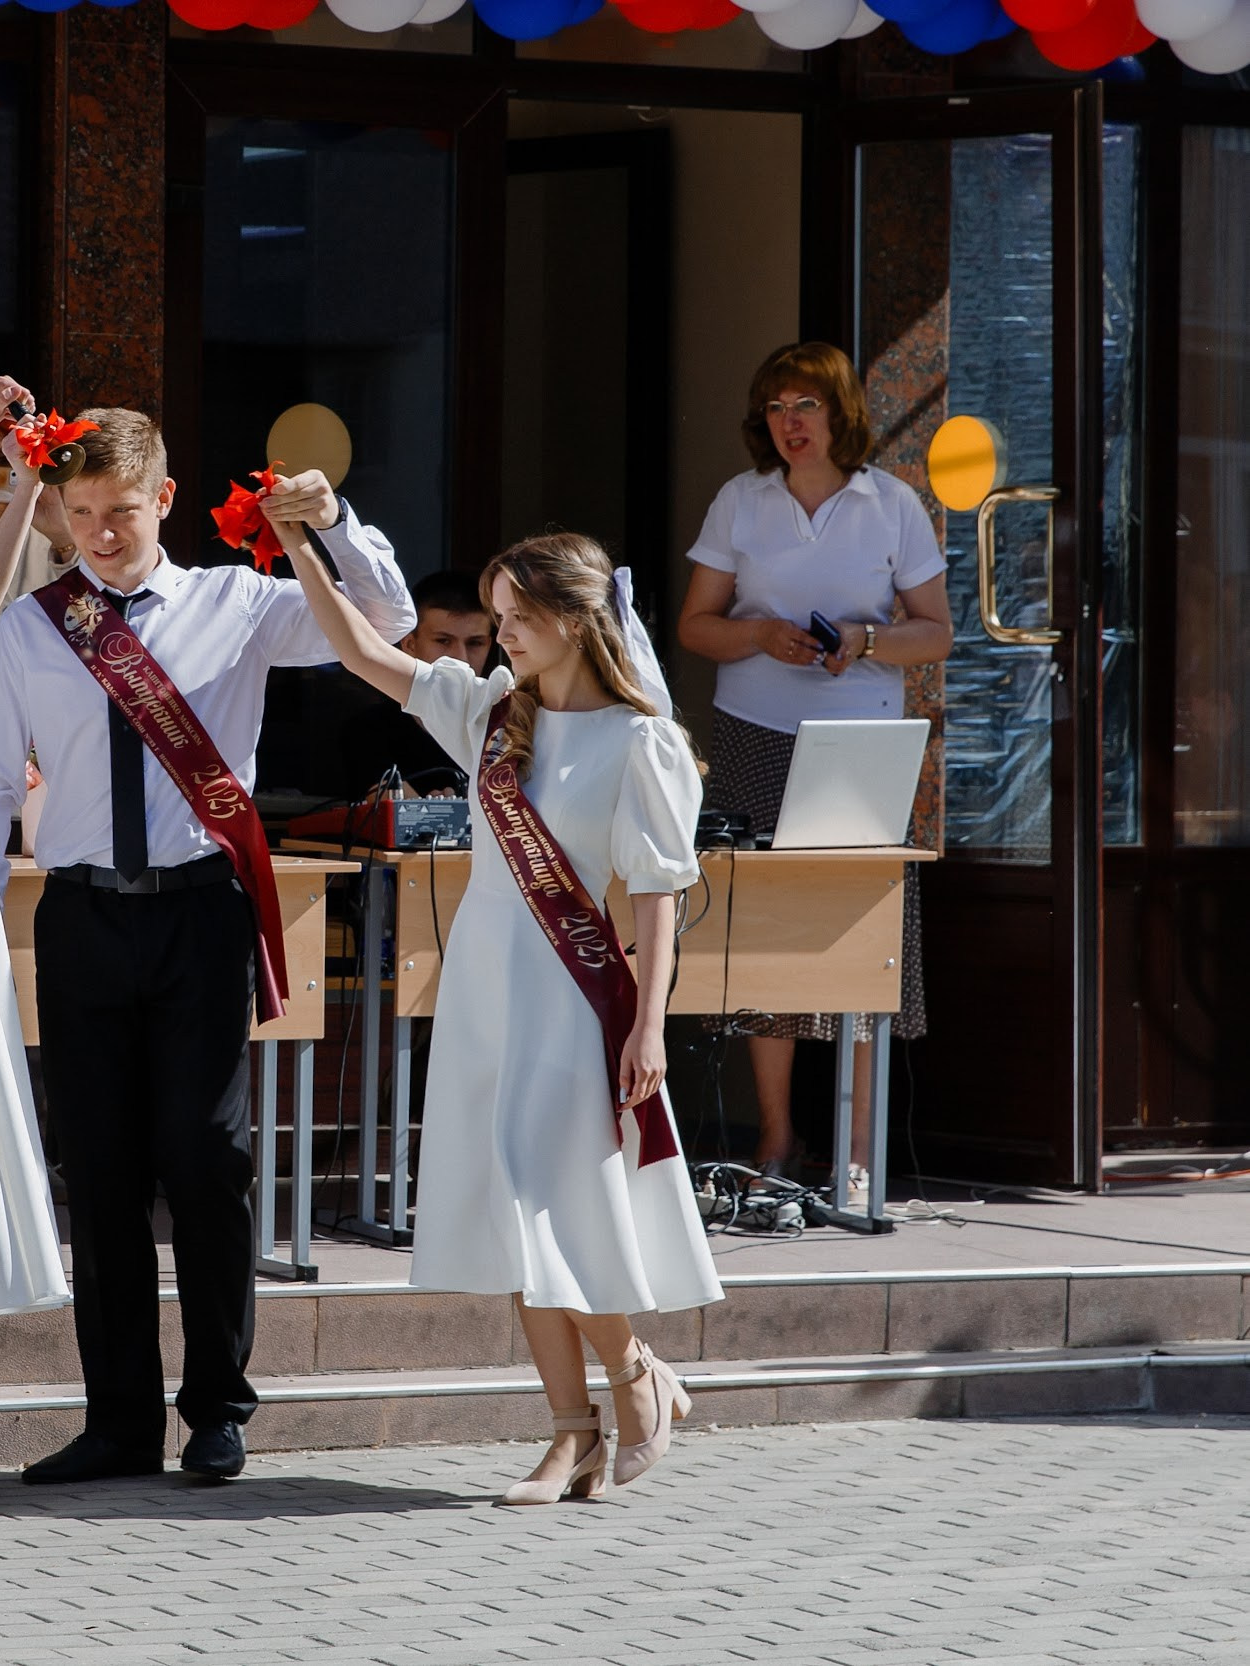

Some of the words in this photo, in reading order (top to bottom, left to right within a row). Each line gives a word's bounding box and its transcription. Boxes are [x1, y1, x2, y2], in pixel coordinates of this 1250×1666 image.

[99, 631, 189, 749] Выпускник
[101, 677, 120, 699] КЛАСС
[190, 763, 248, 819] 2025
[486, 763, 562, 898] Выпускница
[486, 810, 503, 835] КЛАСС
[498, 834, 513, 855] МАОУ
[508, 856, 521, 874] СОШ
[521, 807, 556, 860] МЕЛЬНИКОВА
[551, 859, 575, 893] ПОЛИНА
[556, 911, 618, 969] 2025
